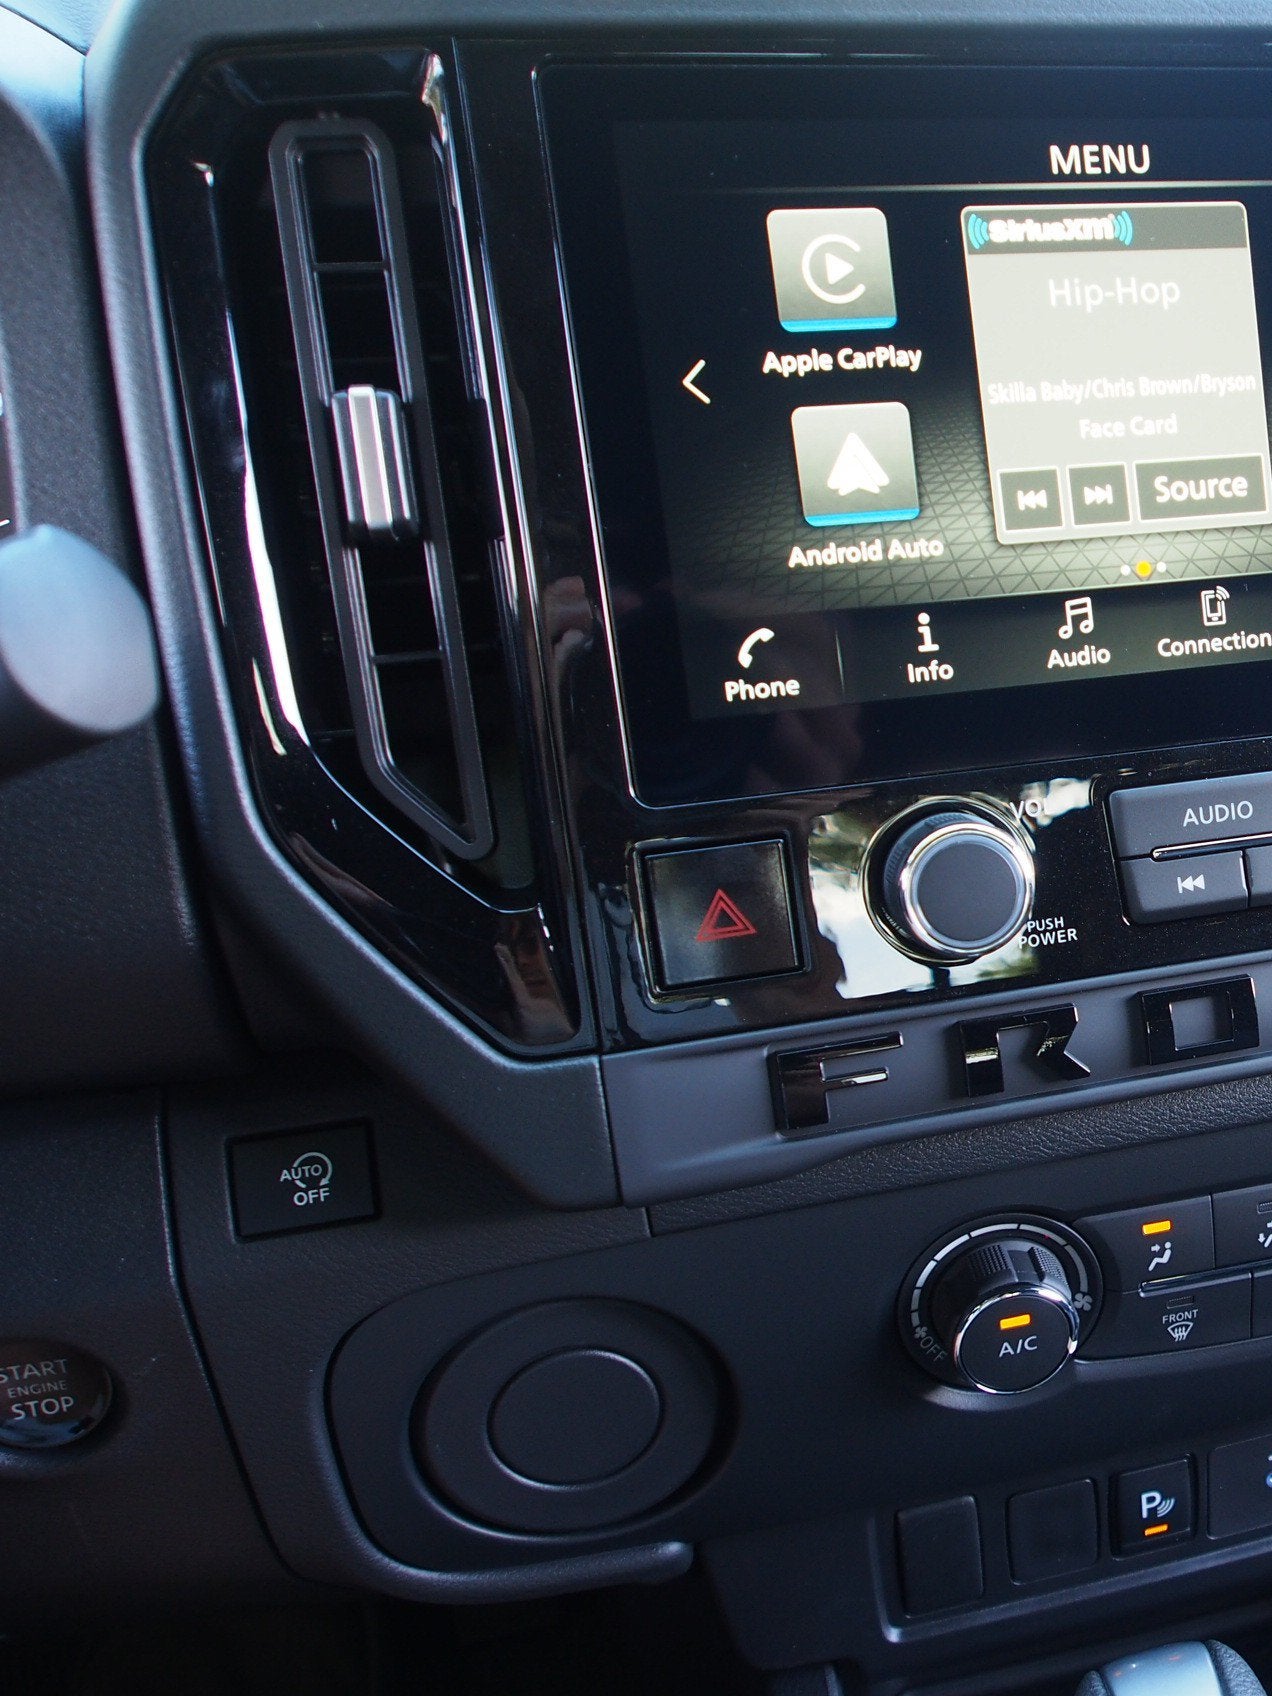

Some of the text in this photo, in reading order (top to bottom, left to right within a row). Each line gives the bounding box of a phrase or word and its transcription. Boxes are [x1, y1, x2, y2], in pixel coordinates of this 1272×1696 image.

[1049, 144, 1151, 175] MENU
[1047, 277, 1181, 313] Hip-Hop
[763, 345, 922, 377] Apple CarPlay
[987, 373, 1257, 405] Skilla Baby/Chris Brown/Bryson
[1079, 412, 1179, 440] Face Card
[1153, 472, 1249, 504] Source
[788, 537, 944, 569] Android Auto
[1047, 640, 1111, 670] Audio
[906, 657, 955, 685] Info
[723, 672, 802, 703] Phone
[1009, 798, 1049, 820] VO
[1182, 799, 1255, 827] AUDIO
[1018, 927, 1078, 949] POWER
[1026, 916, 1065, 933] PUSH
[279, 1162, 323, 1185] AUTO
[293, 1186, 331, 1208] OFF
[1161, 1308, 1199, 1325] FRONT
[919, 1335, 948, 1362] OFF
[999, 1335, 1038, 1357] A/C
[7, 1380, 68, 1399] ENGINE
[11, 1396, 74, 1420] STOP
